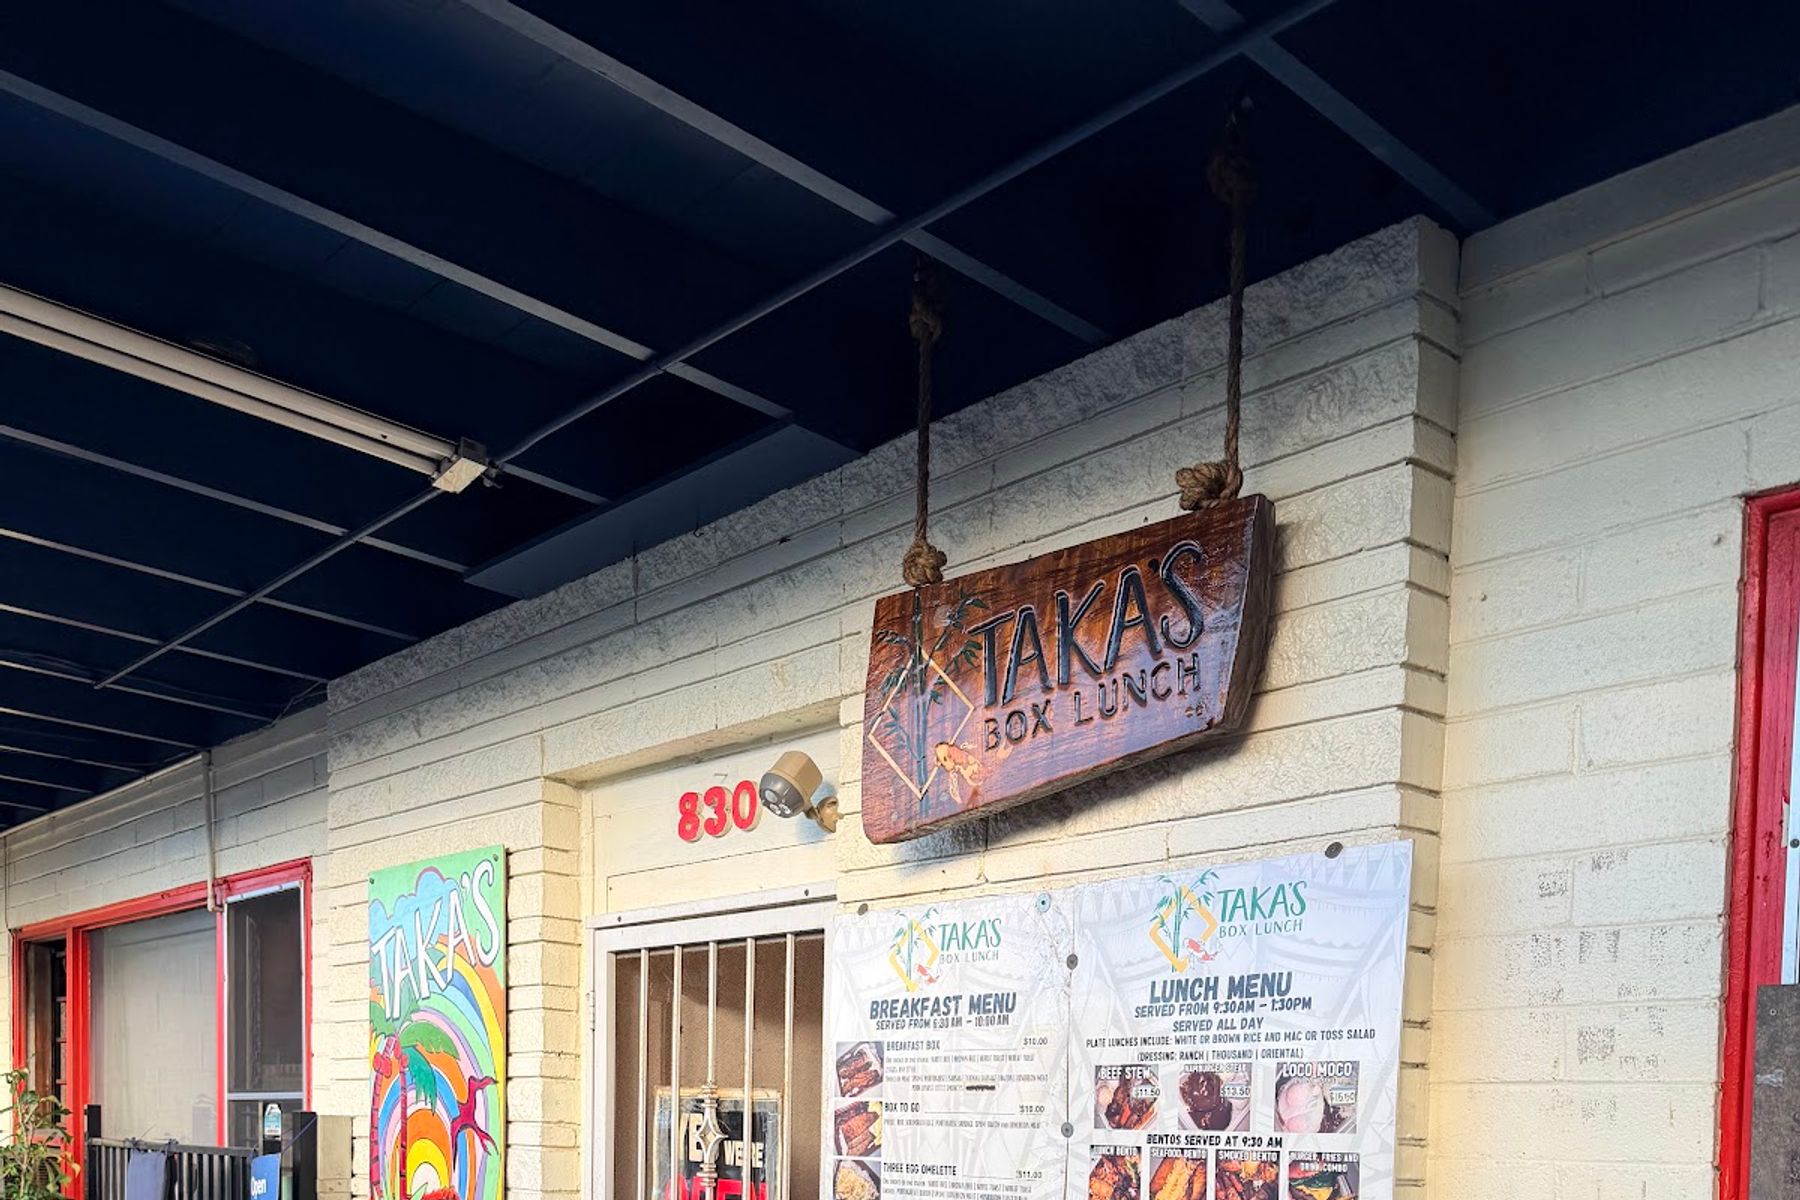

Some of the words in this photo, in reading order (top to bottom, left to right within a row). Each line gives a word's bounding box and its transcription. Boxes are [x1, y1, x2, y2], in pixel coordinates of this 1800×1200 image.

[967, 540, 1206, 708] TAKA'S
[984, 699, 1053, 752] BOX
[1074, 653, 1201, 726] LUNCH
[677, 780, 760, 842] 830
[1218, 880, 1308, 923] TAKA'S
[938, 918, 1002, 951] TAKA'S
[1218, 925, 1248, 939] BOX
[1254, 918, 1304, 937] LUNCH
[370, 858, 500, 1021] TAKA'S
[939, 953, 960, 964] BOX
[964, 950, 999, 962] LUNCH
[1149, 976, 1219, 1004] LUNCH
[1227, 971, 1293, 1000] MENU
[869, 995, 963, 1020] BREAKFAST
[968, 992, 1017, 1016] MENU
[1134, 1003, 1175, 1018] SERVED
[1178, 1003, 1209, 1017] FROM
[1212, 1000, 1255, 1014] 9:30AM
[1271, 997, 1312, 1012] 1:30PM
[876, 1019, 906, 1031] SERVED
[908, 1018, 931, 1030] FROM
[951, 1016, 962, 1028] AM
[996, 1015, 1009, 1026] AM
[1172, 1019, 1213, 1033] SERVED
[1216, 1018, 1239, 1031] ALL
[1240, 1017, 1264, 1031] DAY
[1086, 1038, 1106, 1048] PLATE
[1108, 1037, 1139, 1047] LUNCHES
[1140, 1036, 1173, 1046] INCLUDE:
[1174, 1035, 1197, 1045] WHITE
[1200, 1034, 1210, 1044] OR
[1212, 1034, 1240, 1044] BROWN
[1243, 1033, 1262, 1043] RICE
[1264, 1032, 1281, 1042] AND
[1284, 1031, 1303, 1041] MAC
[1305, 1030, 1317, 1041] OR
[1320, 1030, 1344, 1040] TOSS
[1346, 1029, 1376, 1039] SALAD
[1179, 1050, 1204, 1060] RANCH
[1211, 1049, 1253, 1060] THOUSAND
[1260, 1048, 1304, 1060] ORIENTAL)
[1101, 1067, 1122, 1079] BEEF
[1125, 1066, 1151, 1080] STEW
[1282, 1063, 1313, 1077] LOCO
[1317, 1062, 1353, 1077] MOCO
[900, 1102, 908, 1112] TO
[1146, 1134, 1182, 1145] BENTOS
[1184, 1134, 1221, 1146] SERVED
[1224, 1136, 1239, 1147] AT
[1241, 1136, 1263, 1148] 9:30
[1266, 1136, 1283, 1149] AM
[1219, 1150, 1249, 1160] SMOKED
[1251, 1151, 1278, 1161] BENTO
[1321, 1153, 1342, 1162] FRIES
[1344, 1153, 1359, 1162] AND
[883, 1162, 904, 1173] THREE
[906, 1163, 919, 1174] EGG
[921, 1164, 957, 1176] OMELETTE
